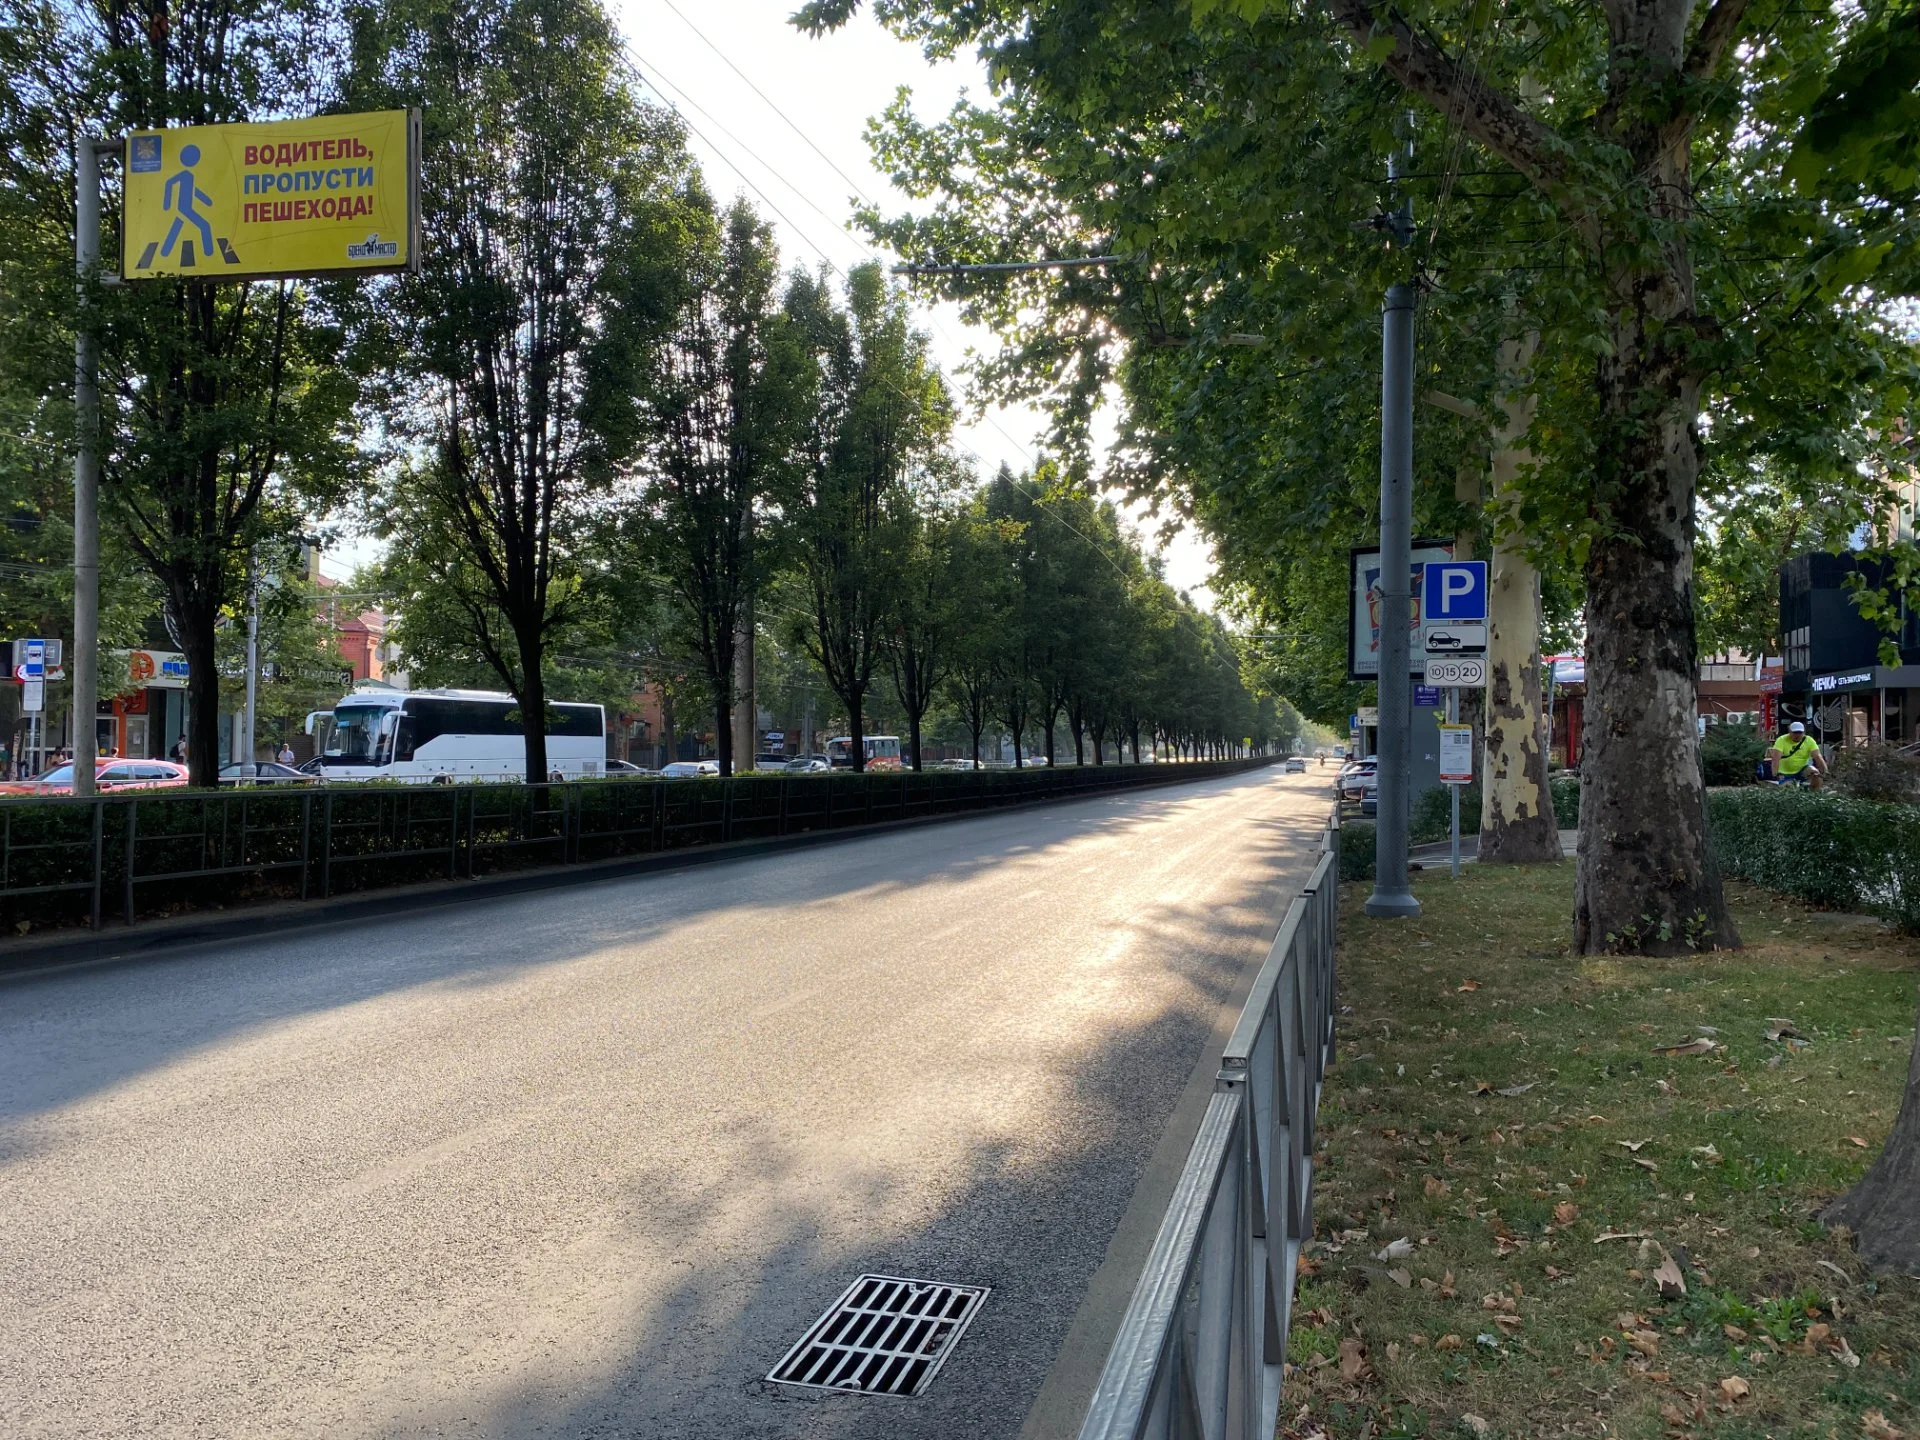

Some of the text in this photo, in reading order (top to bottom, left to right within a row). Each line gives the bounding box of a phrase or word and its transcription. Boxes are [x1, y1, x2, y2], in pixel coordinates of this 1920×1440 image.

[244, 138, 374, 167] ВОДИТЕЛЬ,
[244, 167, 374, 195] ПРОПУСТИ
[243, 195, 374, 223] ПЕШЕХОДА!
[1441, 568, 1475, 613] P
[1431, 667, 1478, 677] 10 15 20
